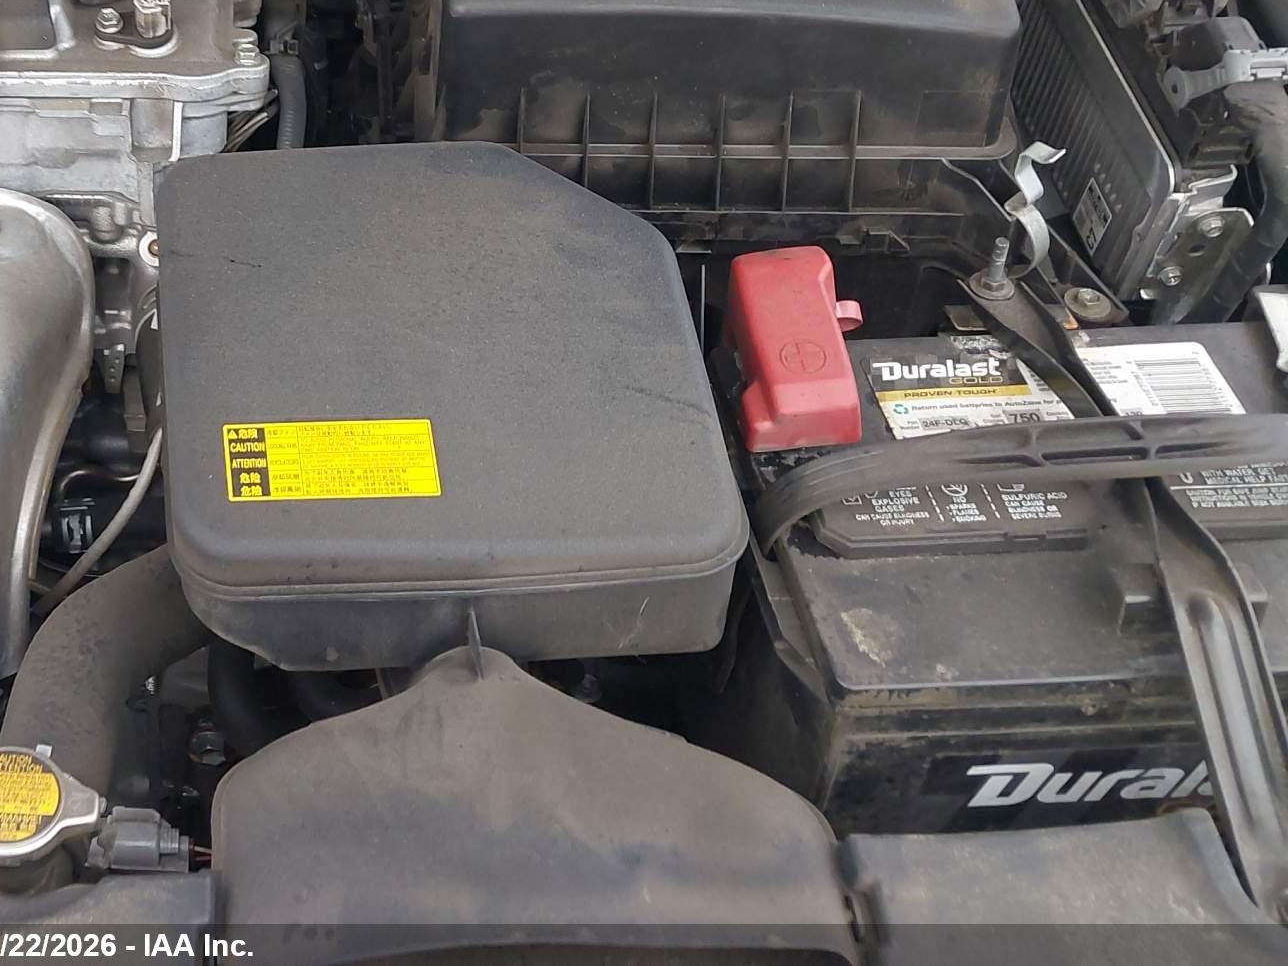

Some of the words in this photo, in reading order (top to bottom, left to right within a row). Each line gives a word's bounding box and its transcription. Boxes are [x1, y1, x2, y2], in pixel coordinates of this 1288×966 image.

[872, 357, 1001, 381] Duralast
[949, 376, 1003, 385] GOLD
[904, 390, 953, 398] PROVEN
[230, 442, 265, 452] CAUTION
[232, 458, 267, 469] ATTENTION
[872, 497, 920, 505] EXPLOSIVE
[952, 496, 967, 504] NO
[1002, 493, 1045, 501] SULFURIC
[1046, 492, 1068, 500] ACID
[874, 505, 905, 513] GASES
